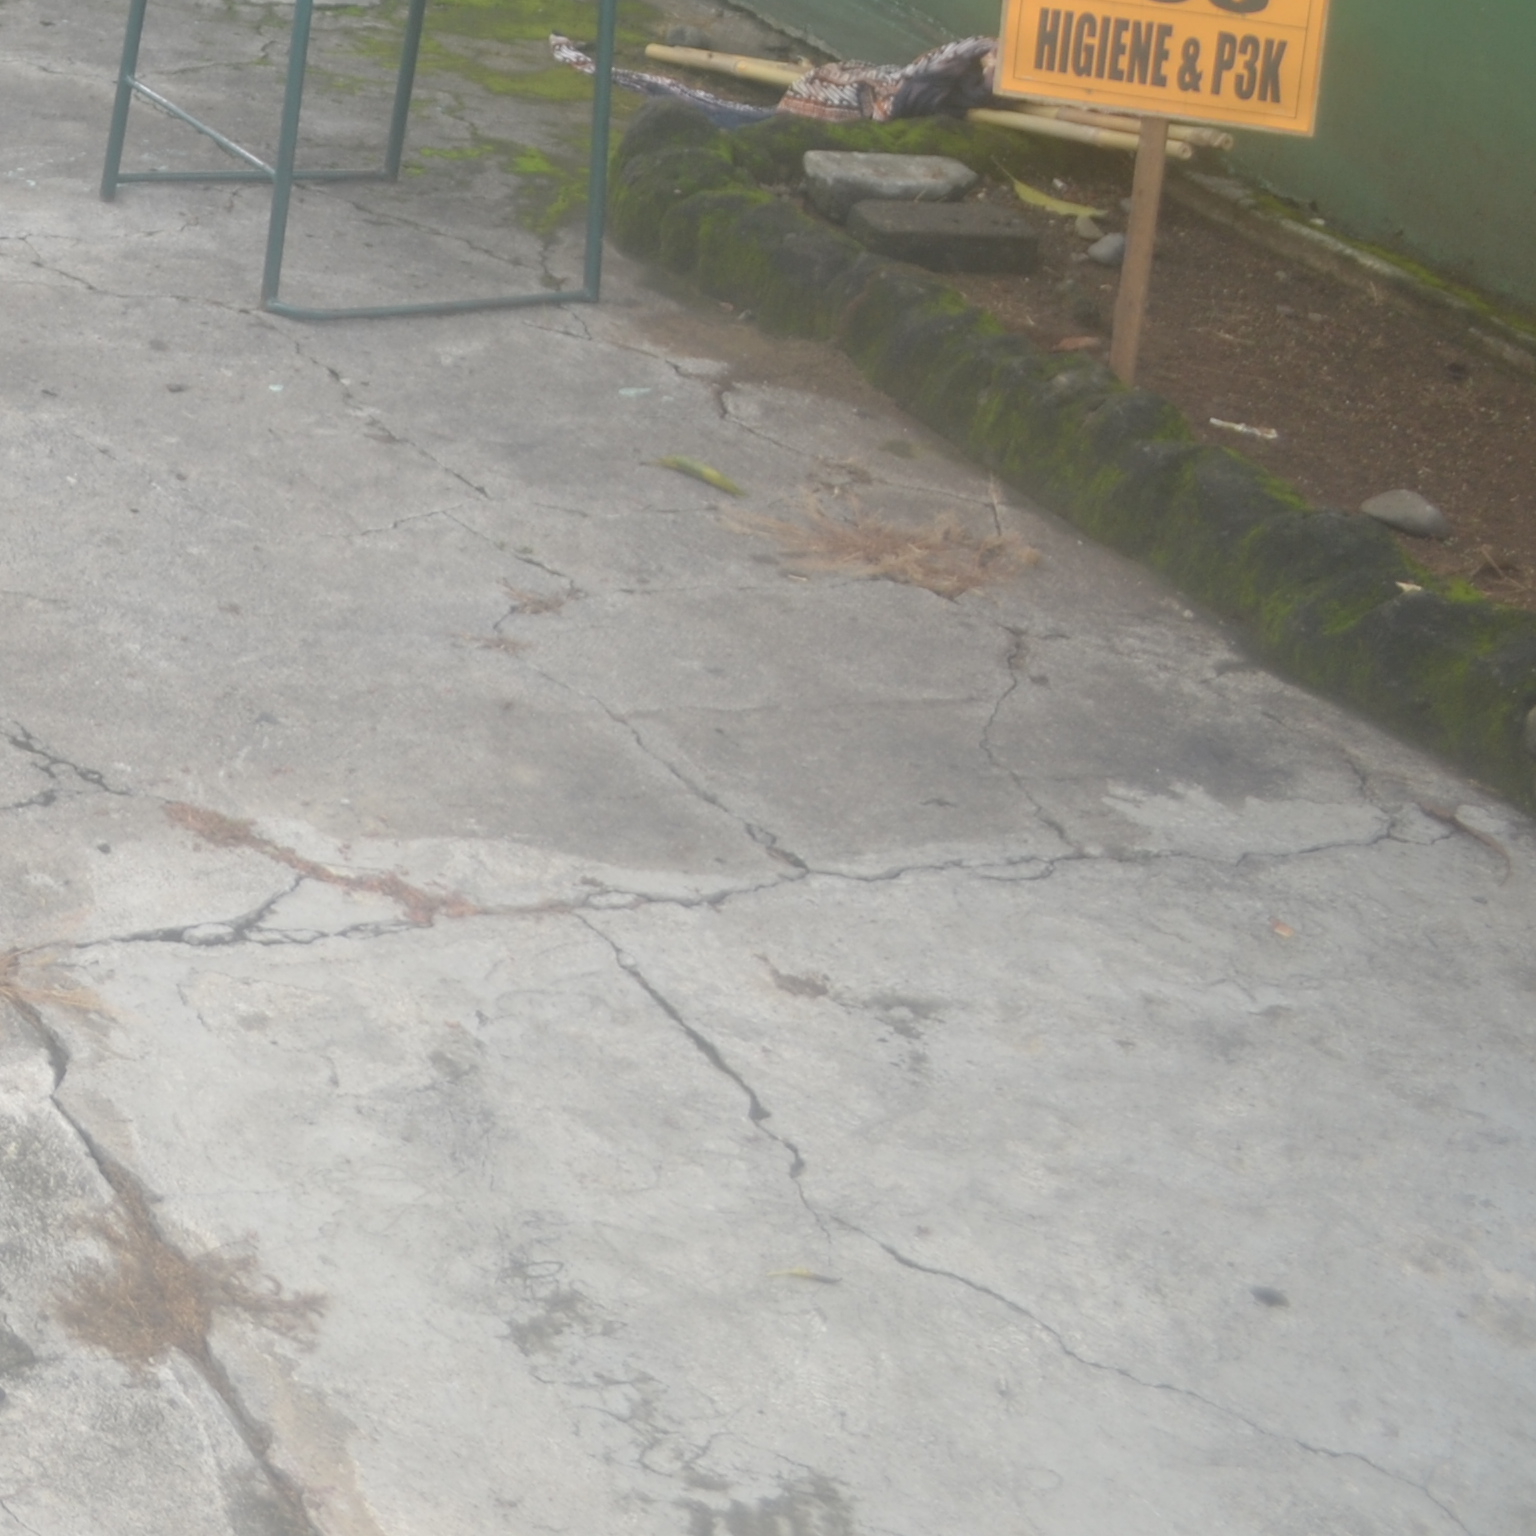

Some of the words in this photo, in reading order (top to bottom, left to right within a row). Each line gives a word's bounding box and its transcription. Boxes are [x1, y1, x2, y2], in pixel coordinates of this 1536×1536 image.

[1033, 7, 1174, 88] HIGIENE
[1176, 36, 1204, 94] &
[1210, 30, 1288, 104] P3K
